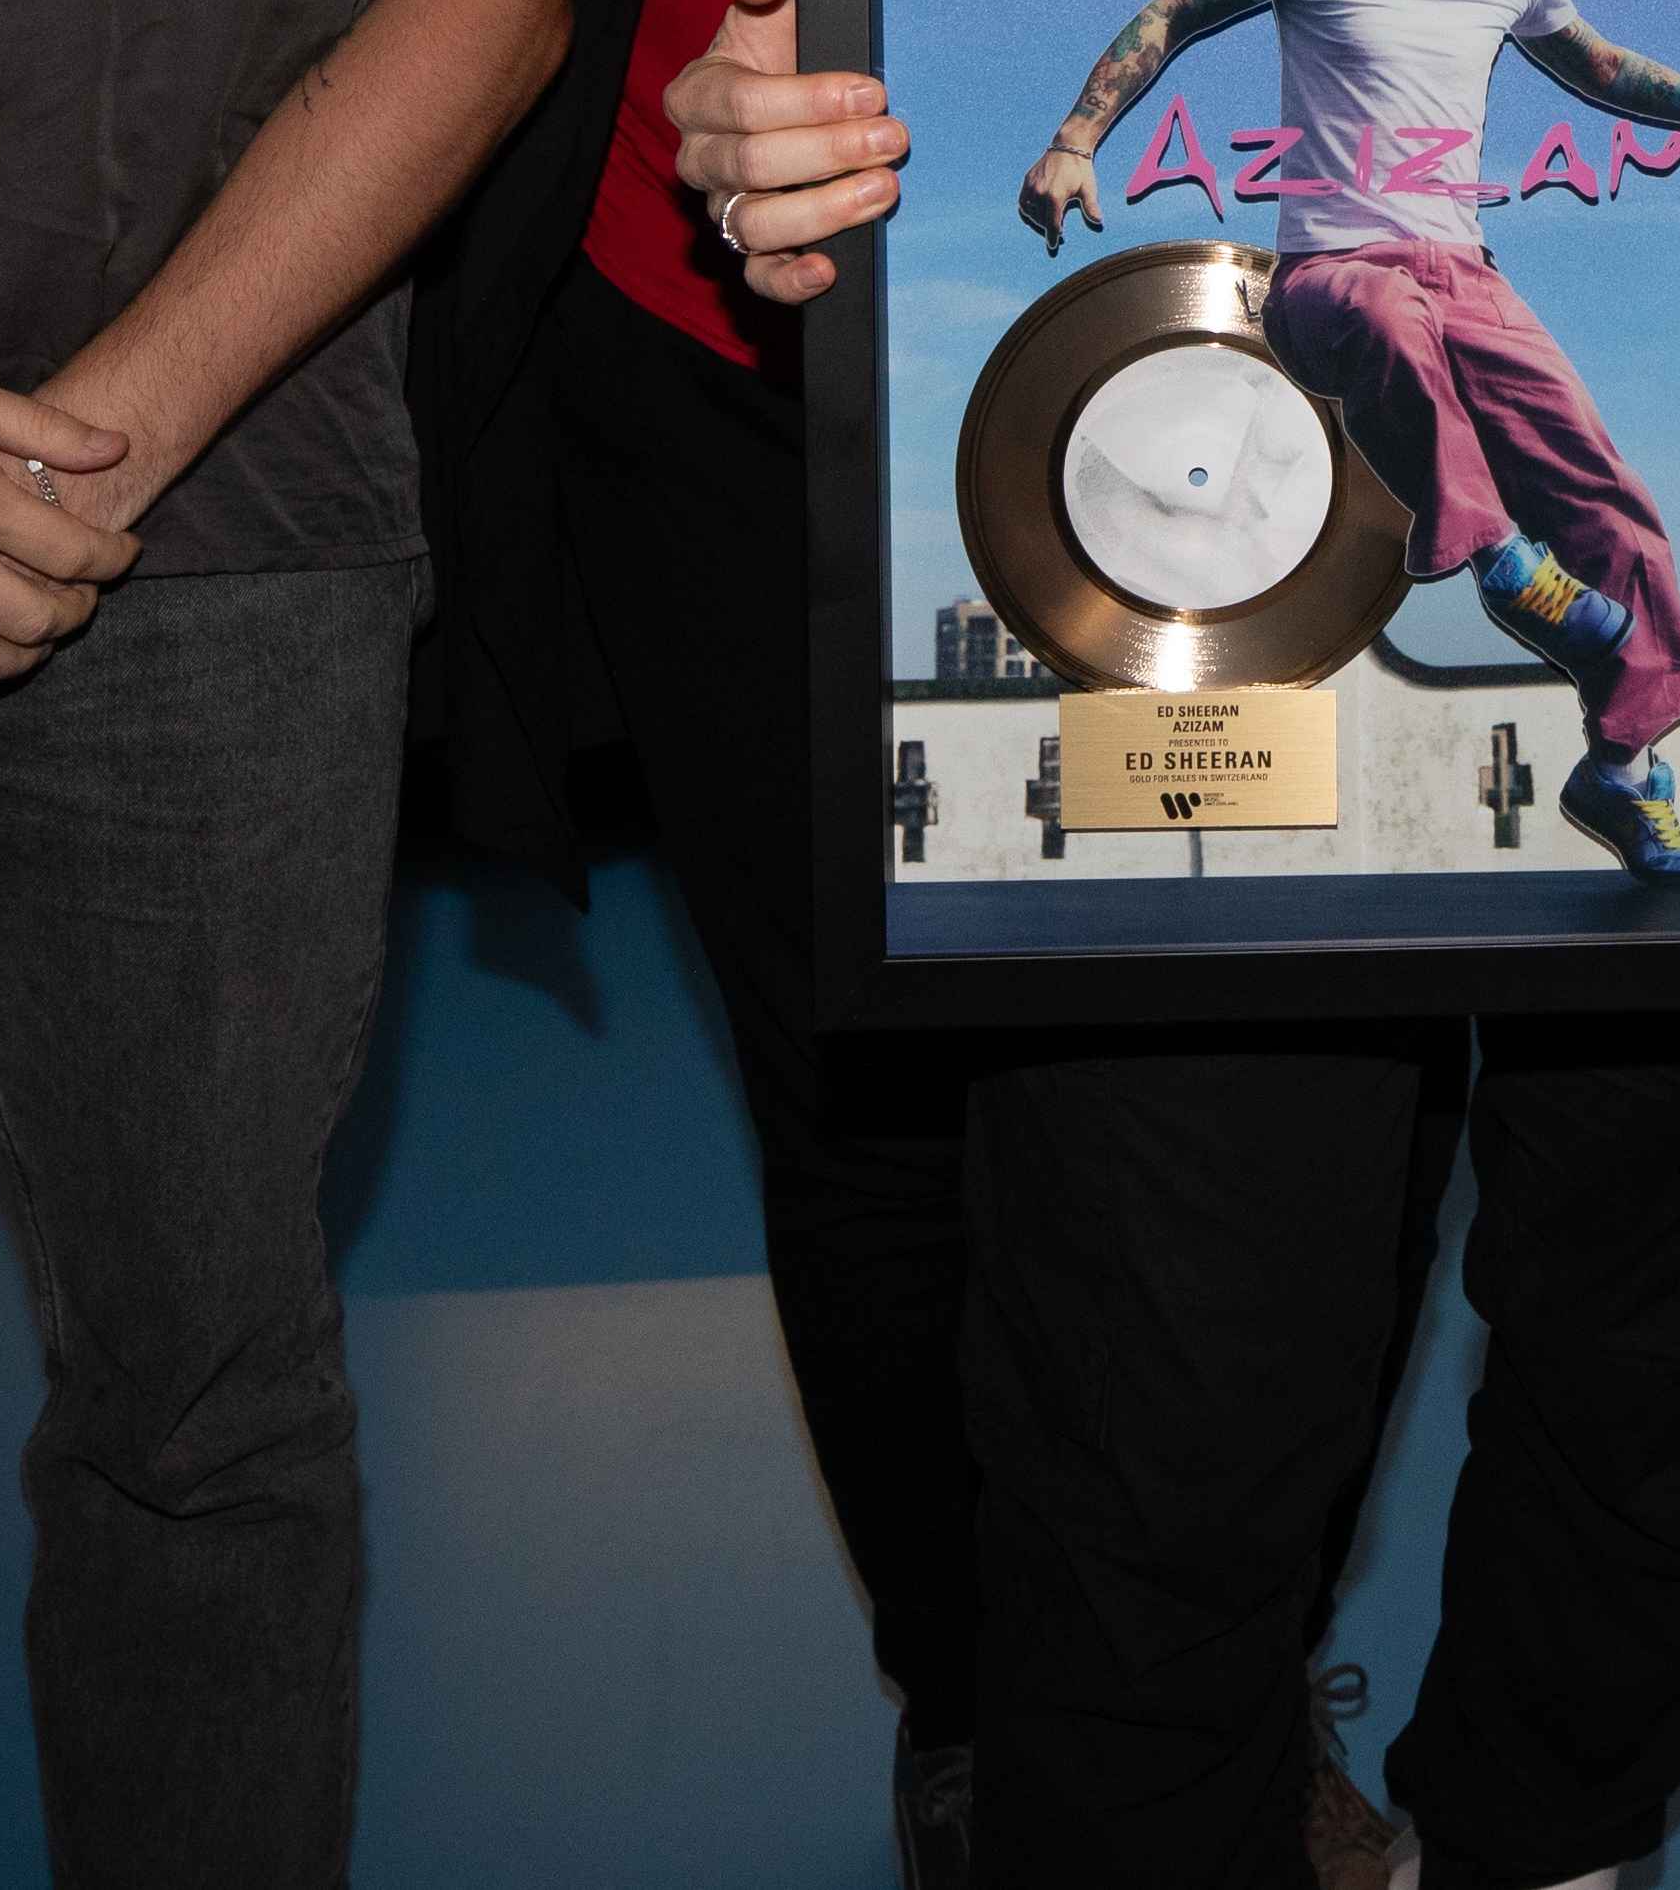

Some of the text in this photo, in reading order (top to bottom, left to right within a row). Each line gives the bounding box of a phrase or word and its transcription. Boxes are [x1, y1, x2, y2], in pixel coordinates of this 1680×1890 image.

[1158, 705, 1239, 718] ED SHEERAN
[1173, 721, 1224, 733] AZIZAM
[1169, 738, 1229, 748] PRESENTED TO
[1125, 751, 1272, 771] ED SHEERAN
[1129, 773, 1269, 784] GOLD FOR SALES IN SWITZERLAND
